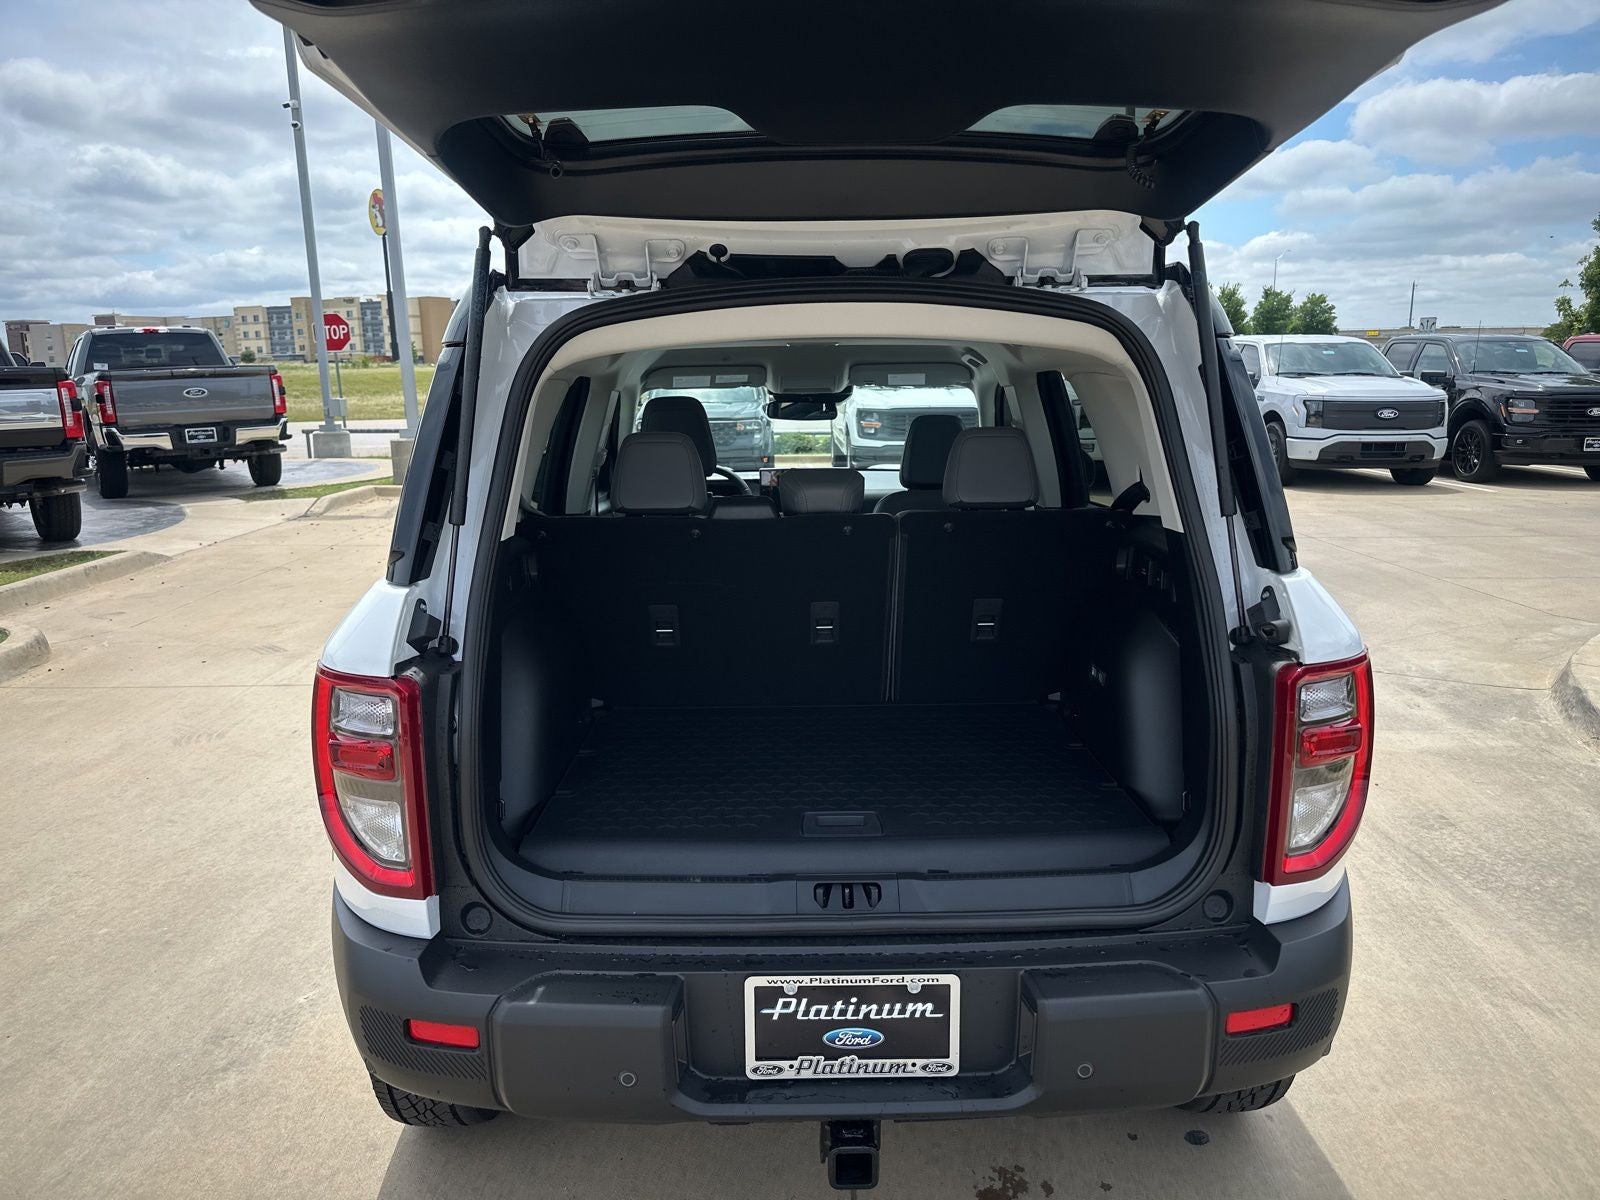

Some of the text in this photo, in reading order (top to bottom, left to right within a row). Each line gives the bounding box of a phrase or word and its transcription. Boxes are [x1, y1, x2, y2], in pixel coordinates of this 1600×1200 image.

[323, 325, 348, 340] TOP
[766, 976, 940, 985] www.PlatinumFord.com
[760, 997, 945, 1021] Platinum
[834, 1030, 872, 1046] Ford
[755, 1064, 779, 1075] Ford
[795, 1057, 916, 1076] Platinum
[925, 1063, 948, 1073] Ford
